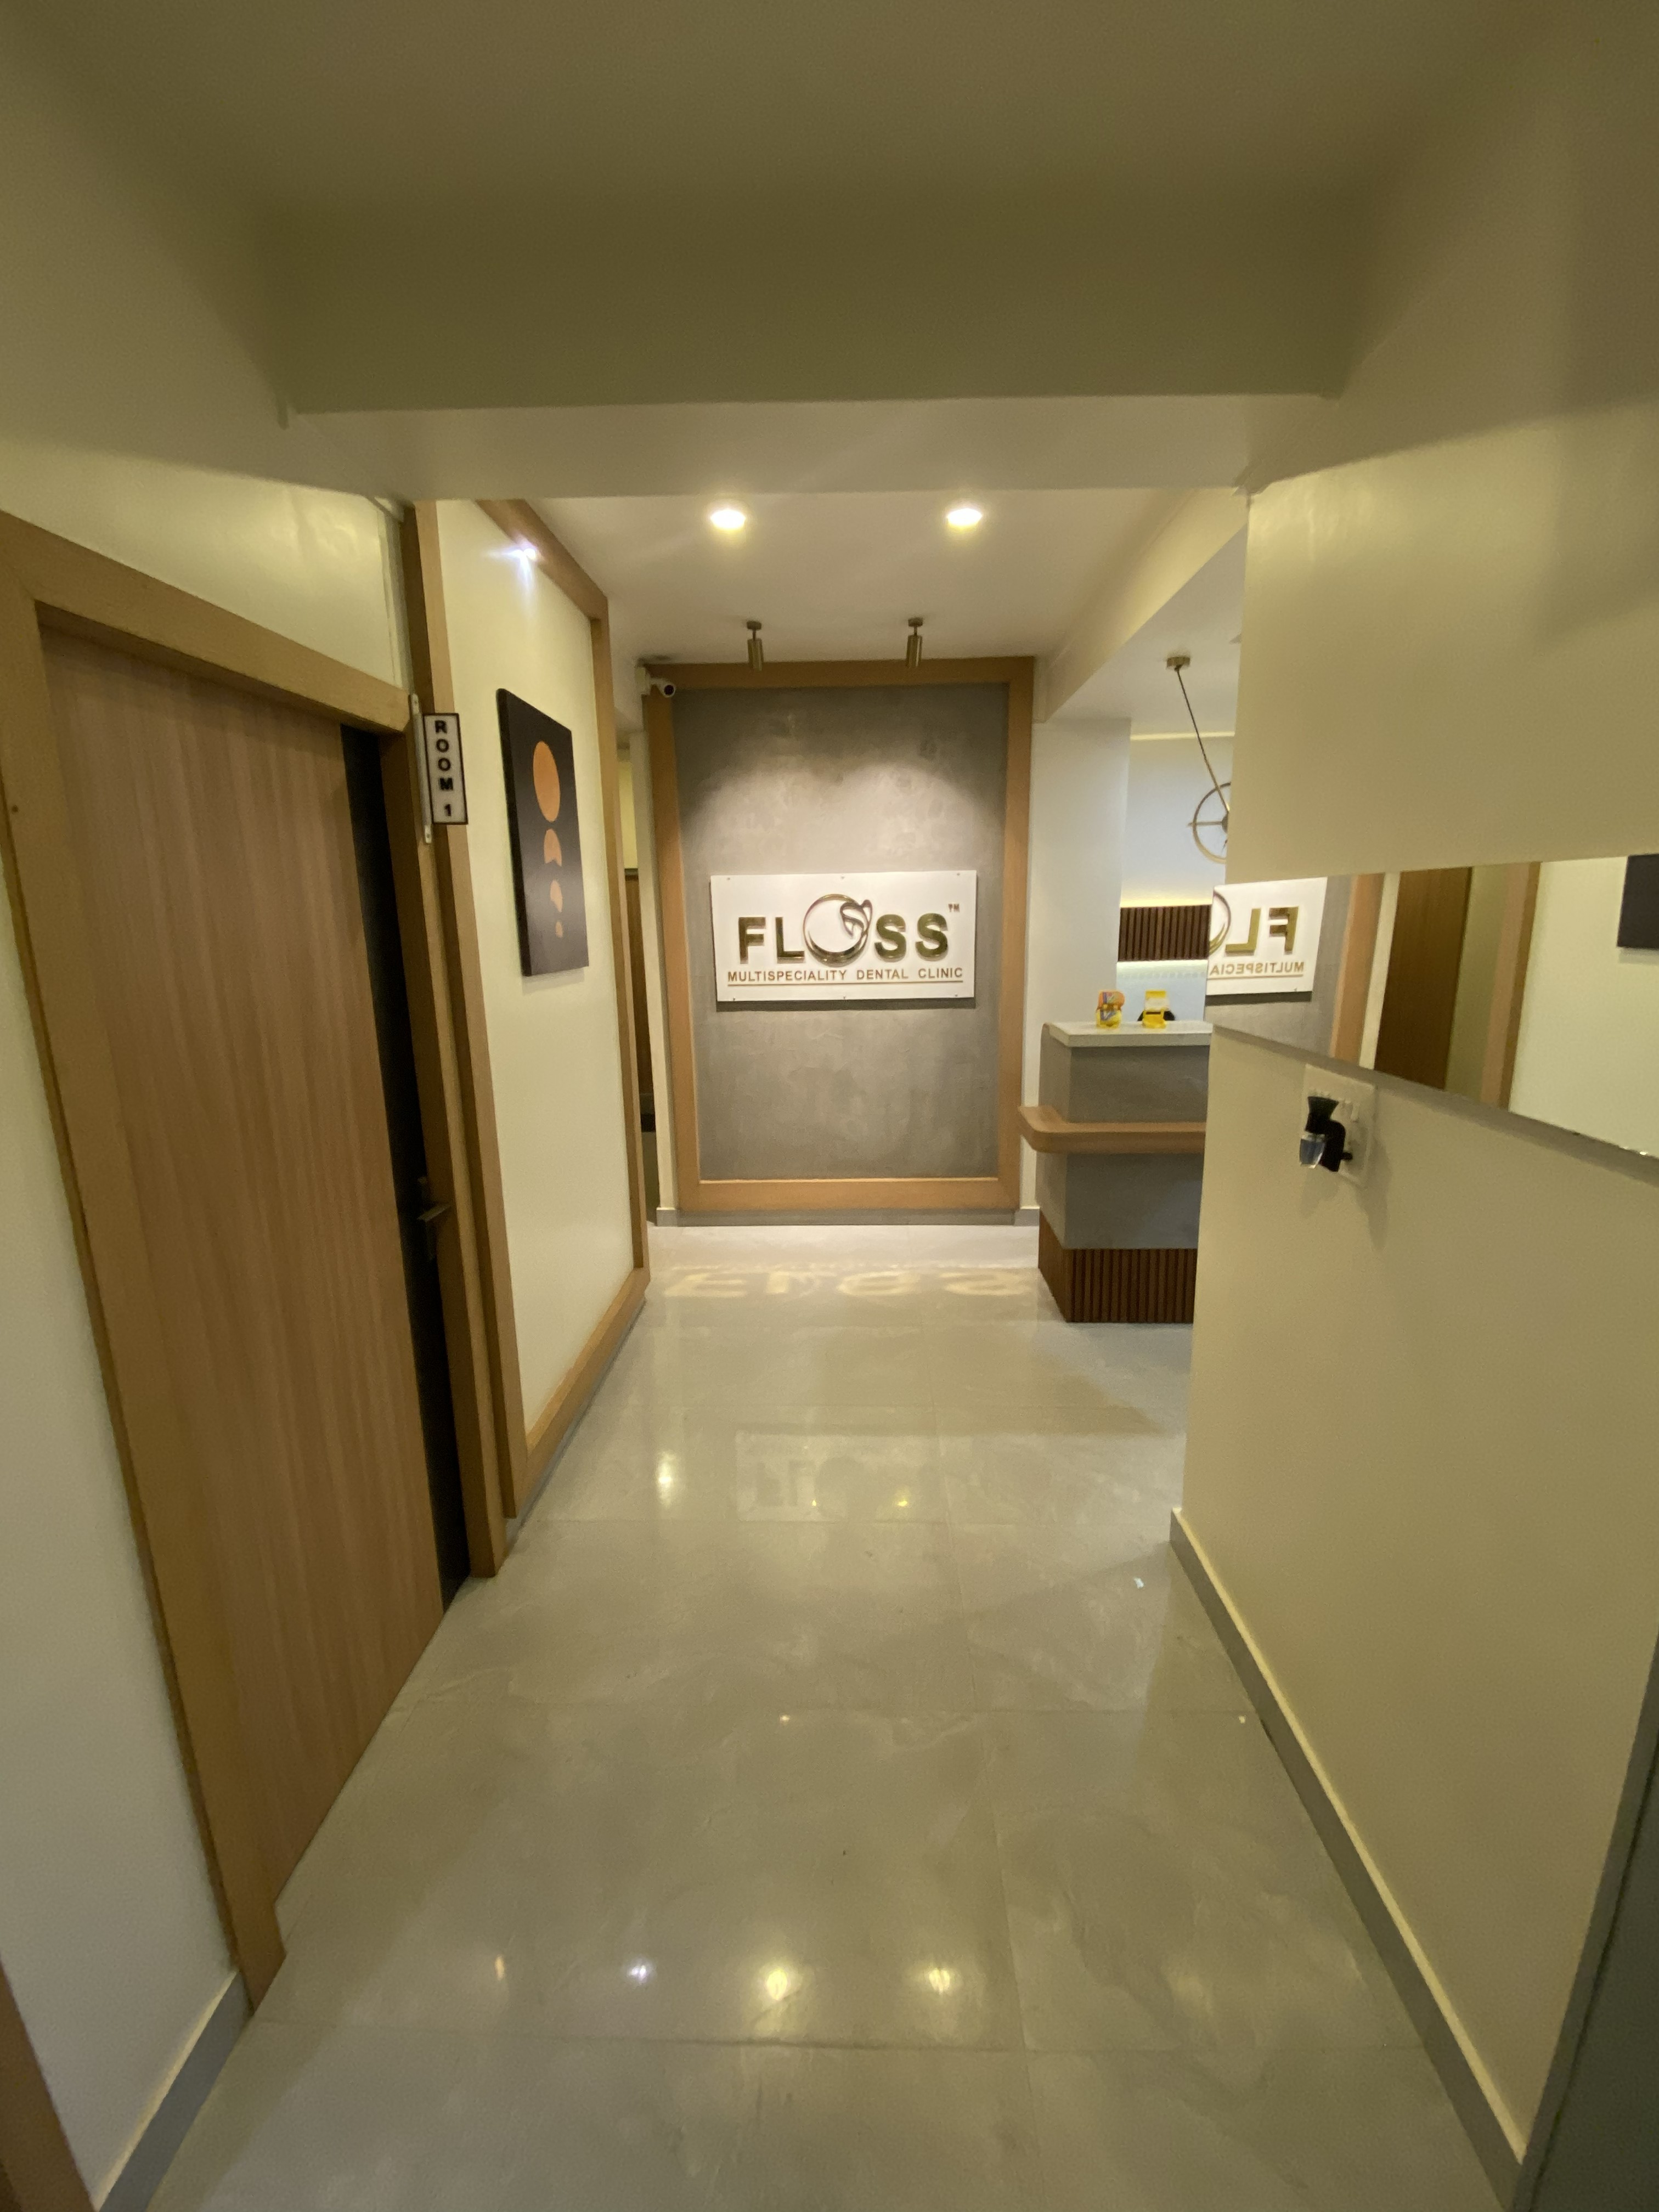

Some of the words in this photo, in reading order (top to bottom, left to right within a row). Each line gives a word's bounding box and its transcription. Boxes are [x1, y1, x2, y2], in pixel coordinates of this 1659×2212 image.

[435, 720, 454, 791] ROOM
[444, 804, 452, 817] 1
[738, 894, 949, 968] FLOSS
[728, 970, 845, 982] MULTISPECIALITY
[857, 968, 909, 979] DENTAL
[918, 967, 963, 978] CLINIC
